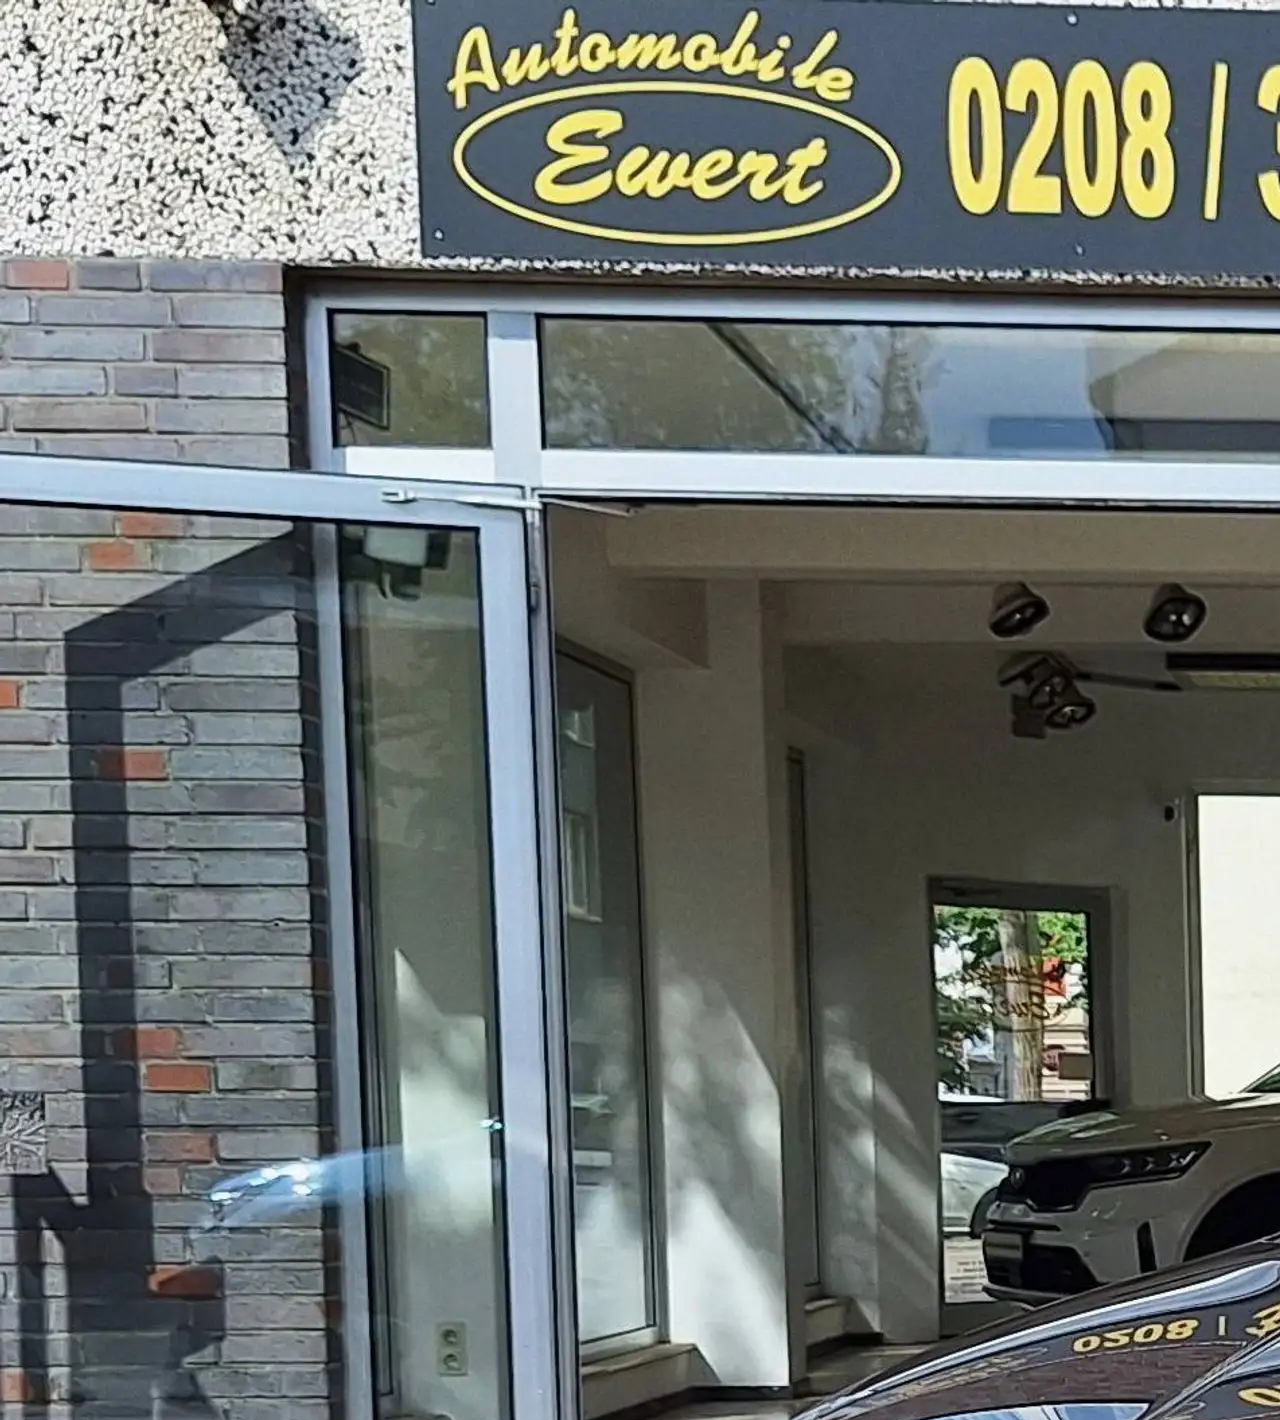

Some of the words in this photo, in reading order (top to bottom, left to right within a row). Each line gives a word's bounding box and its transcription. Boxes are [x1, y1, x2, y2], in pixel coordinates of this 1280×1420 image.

[446, 7, 856, 109] Automobile
[534, 109, 828, 204] Ewert
[947, 56, 1176, 219] 0208
[1203, 62, 1228, 221] /
